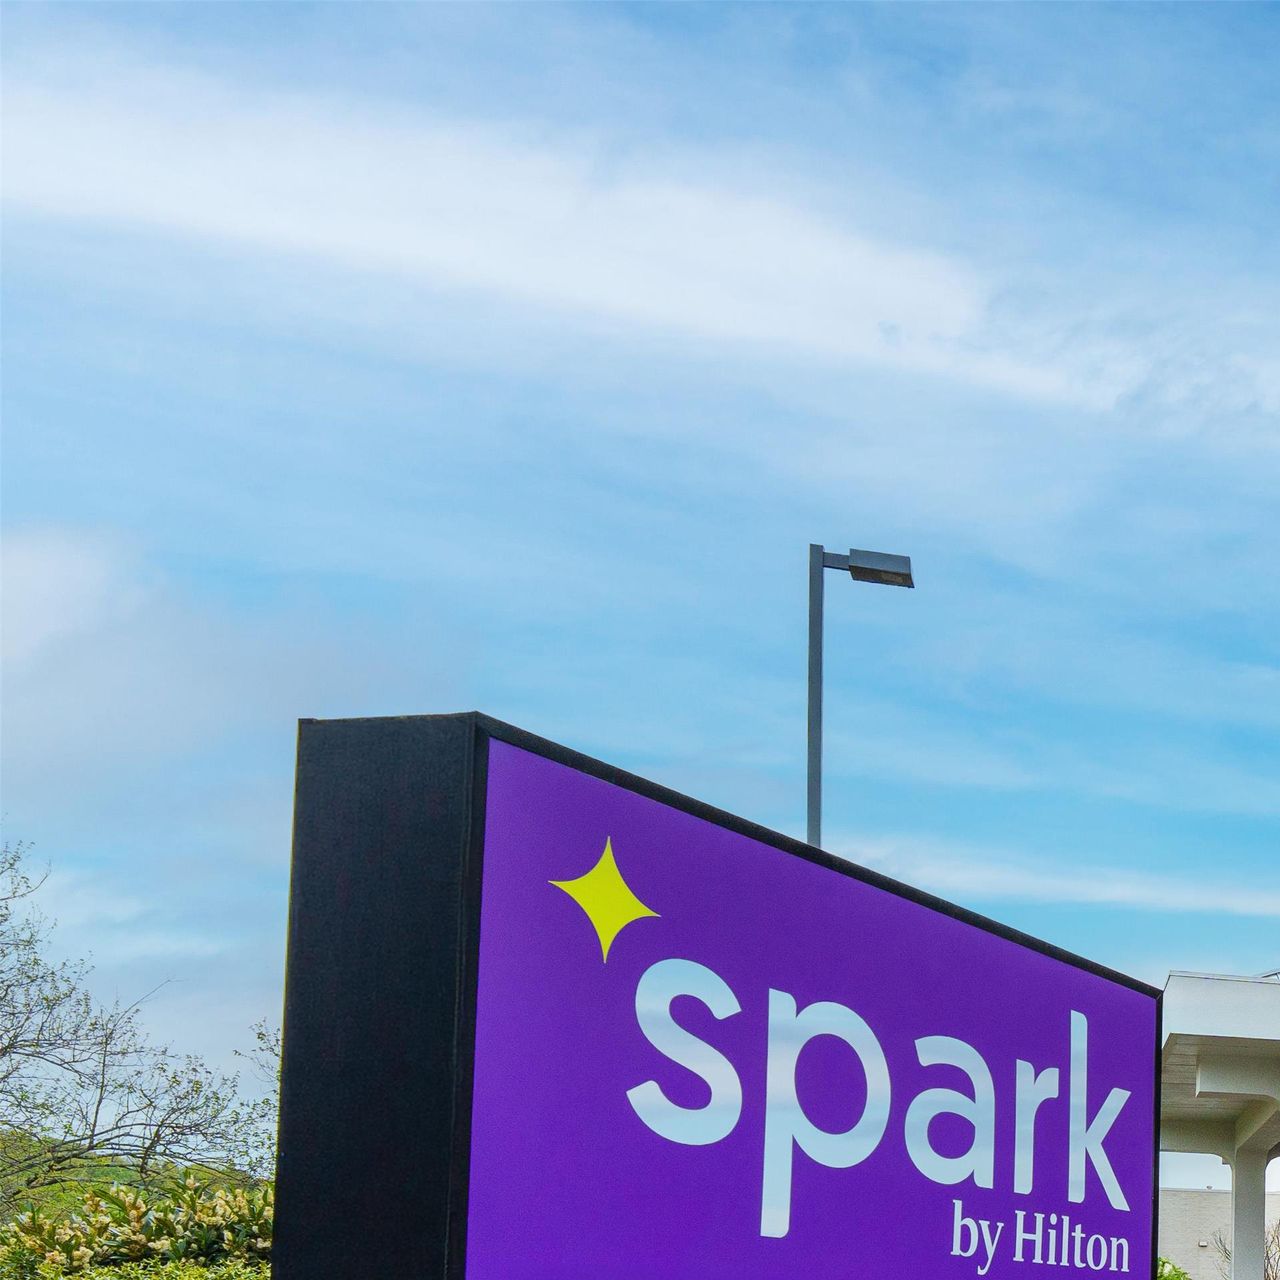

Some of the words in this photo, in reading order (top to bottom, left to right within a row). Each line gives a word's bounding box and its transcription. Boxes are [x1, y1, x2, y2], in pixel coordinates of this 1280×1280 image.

[625, 957, 1132, 1238] spark
[950, 1199, 1005, 1276] by
[1012, 1209, 1131, 1273] Hilton
